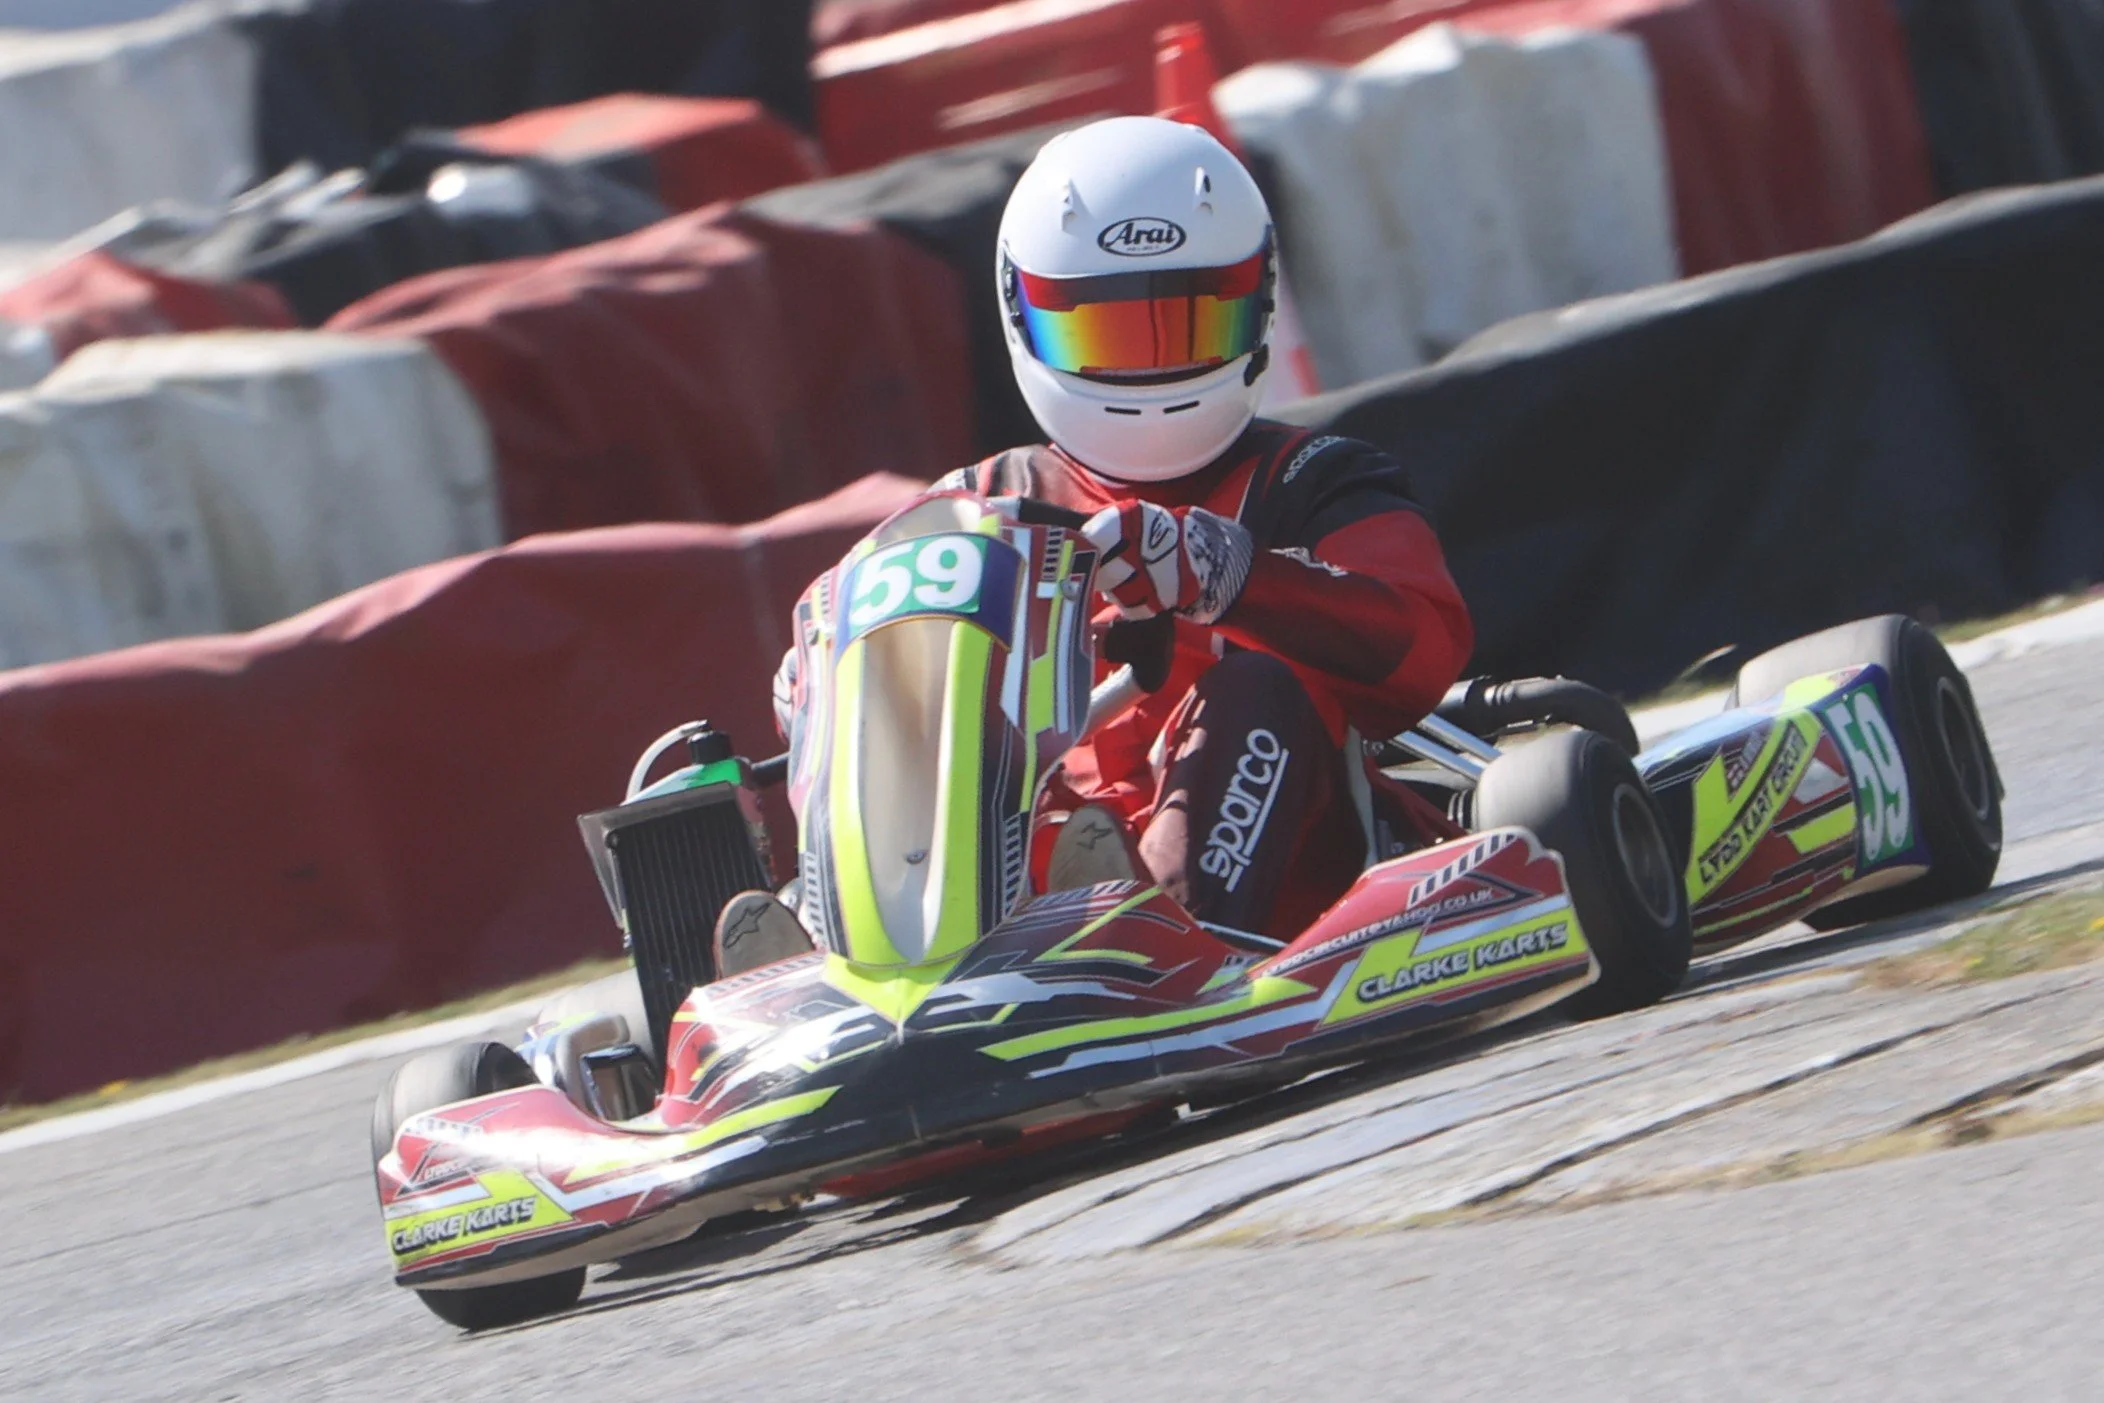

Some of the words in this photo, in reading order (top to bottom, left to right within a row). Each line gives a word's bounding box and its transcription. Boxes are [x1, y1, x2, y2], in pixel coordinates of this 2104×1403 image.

[1104, 222, 1175, 248] Arai
[850, 536, 983, 625] 59
[1200, 728, 1288, 892] sparco
[1826, 692, 1910, 861] 59
[1358, 951, 1470, 1002] CLARKE
[1474, 921, 1568, 968] KARTS
[393, 1214, 462, 1255] CLARKE
[463, 1197, 536, 1236] KARTS
